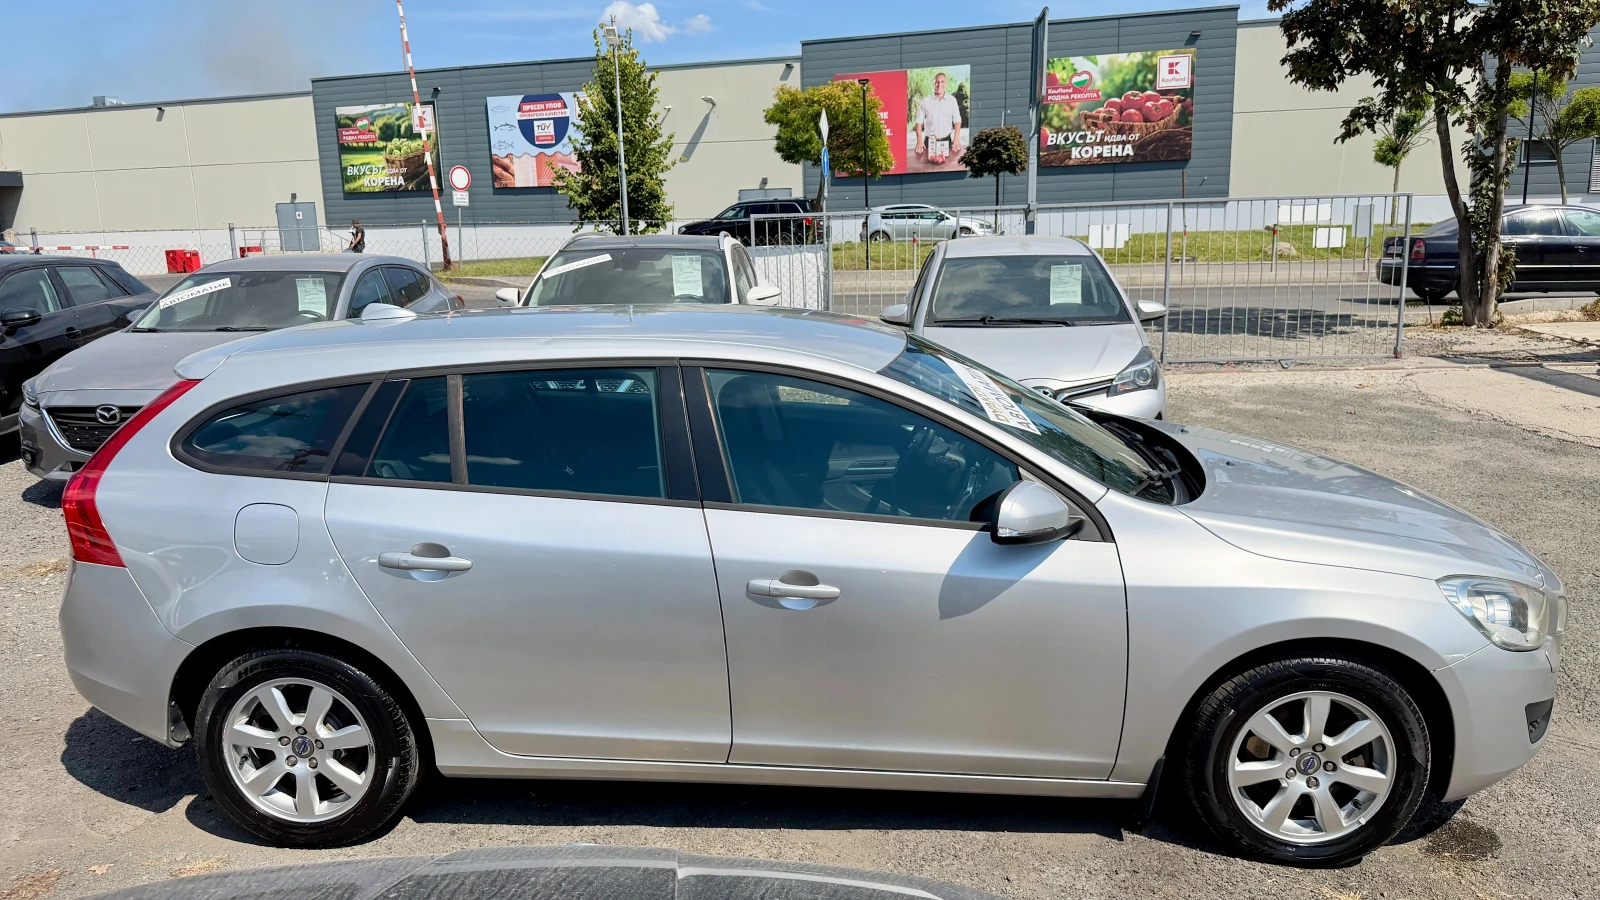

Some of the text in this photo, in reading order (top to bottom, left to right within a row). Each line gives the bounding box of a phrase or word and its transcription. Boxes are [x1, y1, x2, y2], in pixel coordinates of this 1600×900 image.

[522, 103, 545, 111] ПРЕСЕН
[1047, 130, 1106, 146] ВКУСЪТ
[1104, 135, 1127, 143] ИДВА
[1071, 144, 1134, 159] КОРЕНА
[347, 165, 384, 176] ВКУСЪТ
[364, 176, 405, 187] КОРЕНА
[162, 281, 229, 307] АВТОМАТИК
